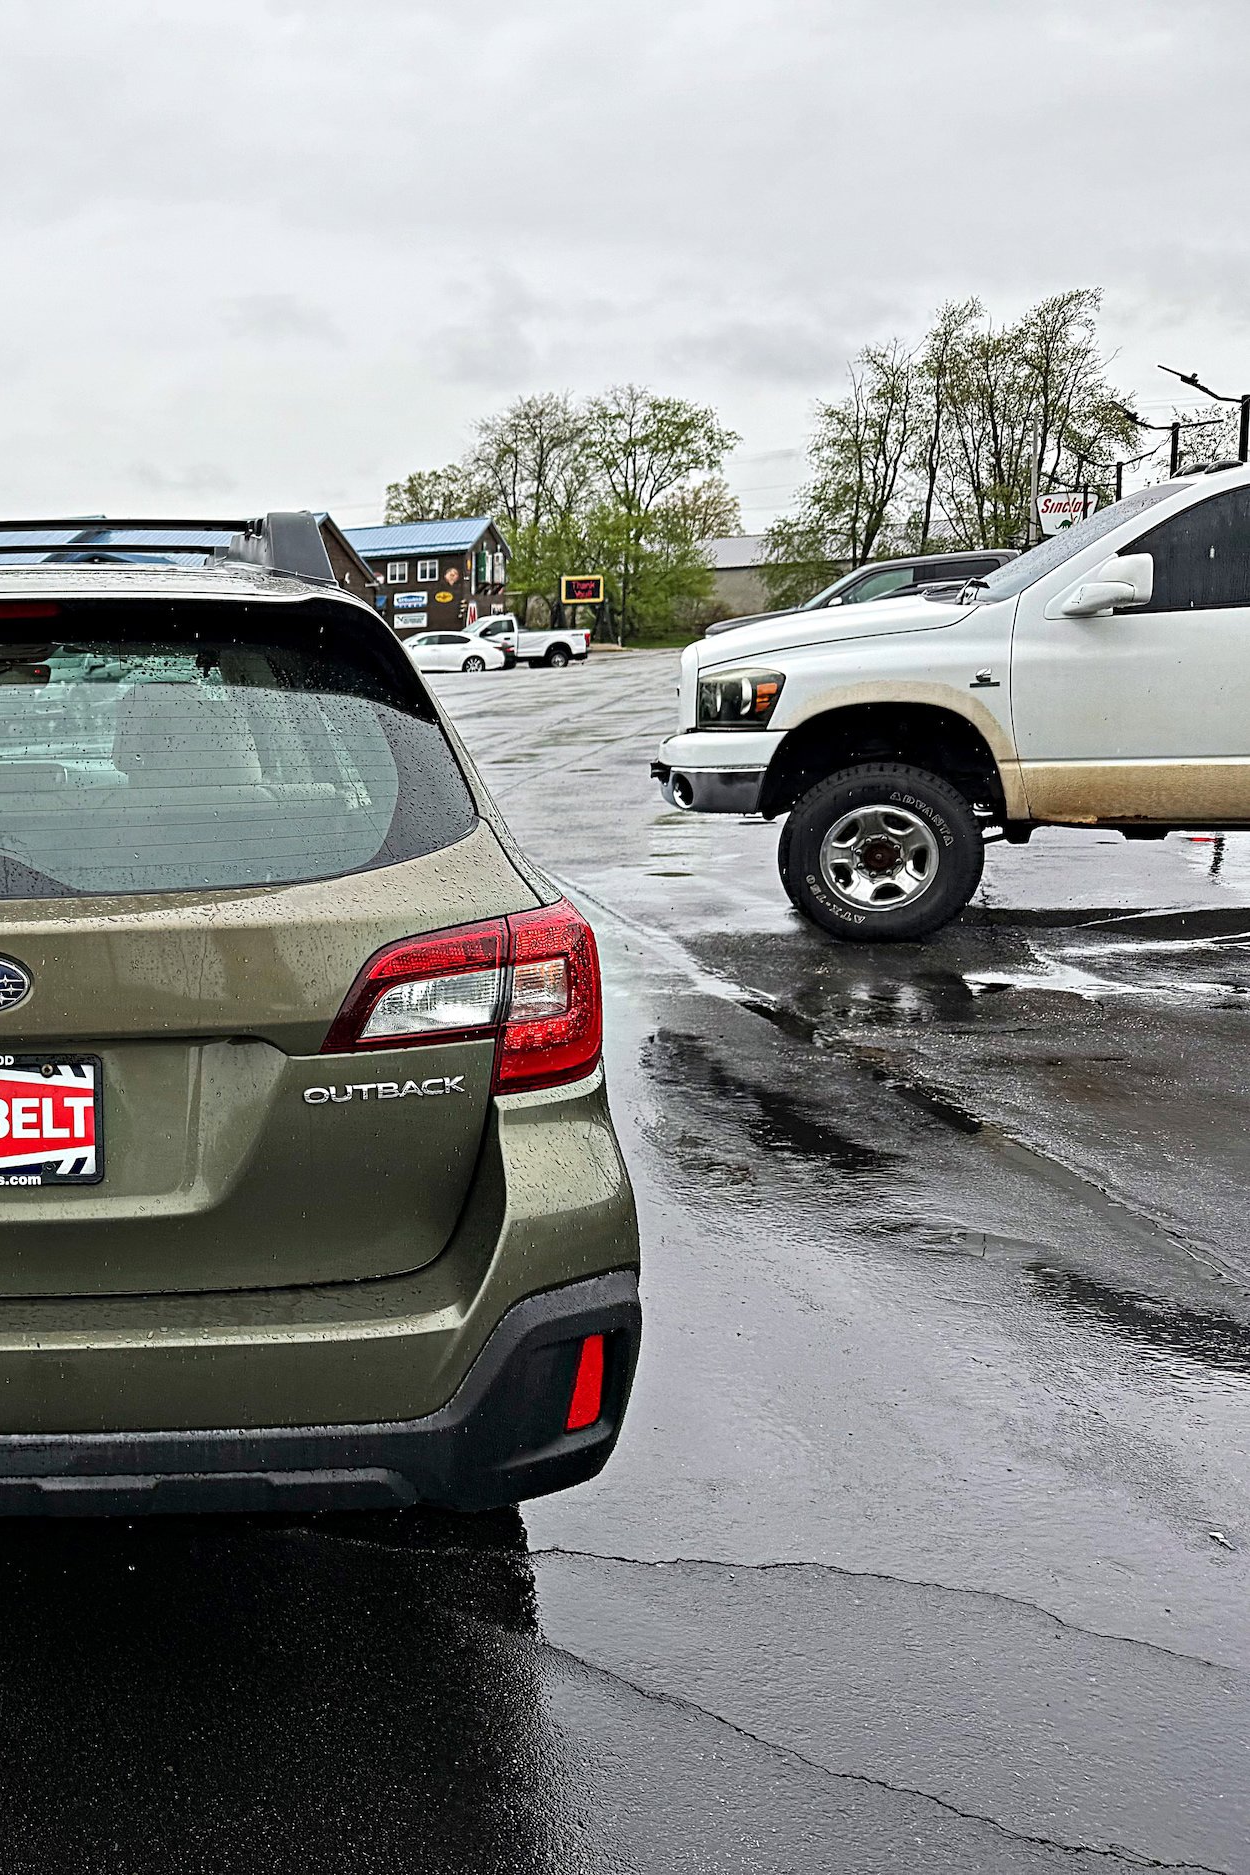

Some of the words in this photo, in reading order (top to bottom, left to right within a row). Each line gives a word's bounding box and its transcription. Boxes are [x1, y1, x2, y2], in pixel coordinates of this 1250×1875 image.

[1041, 497, 1093, 513] Sinclar
[889, 791, 954, 846] ADVANTA
[303, 1075, 465, 1104] OUTBACK
